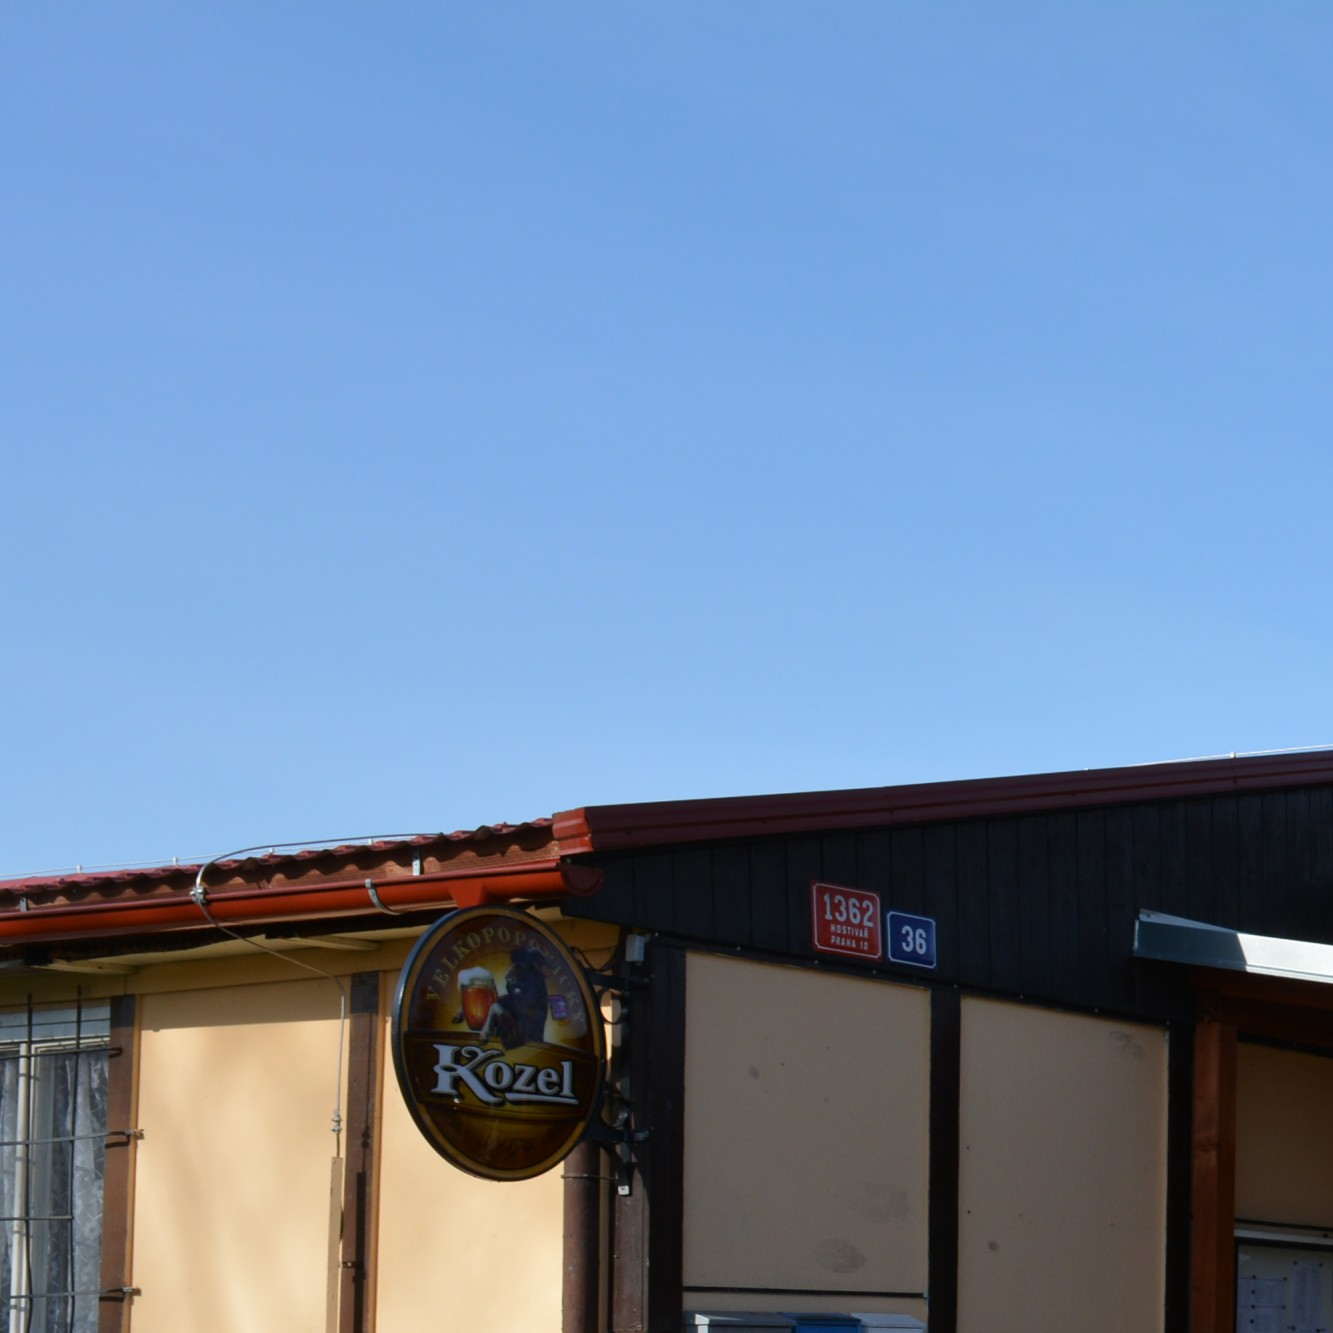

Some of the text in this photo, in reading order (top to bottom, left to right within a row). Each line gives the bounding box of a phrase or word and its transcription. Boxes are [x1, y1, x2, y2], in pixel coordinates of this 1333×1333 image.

[823, 892, 874, 928] 1362
[831, 935, 869, 951] PRAHA 10
[901, 925, 927, 955] 36
[429, 1043, 579, 1105] Kozel
